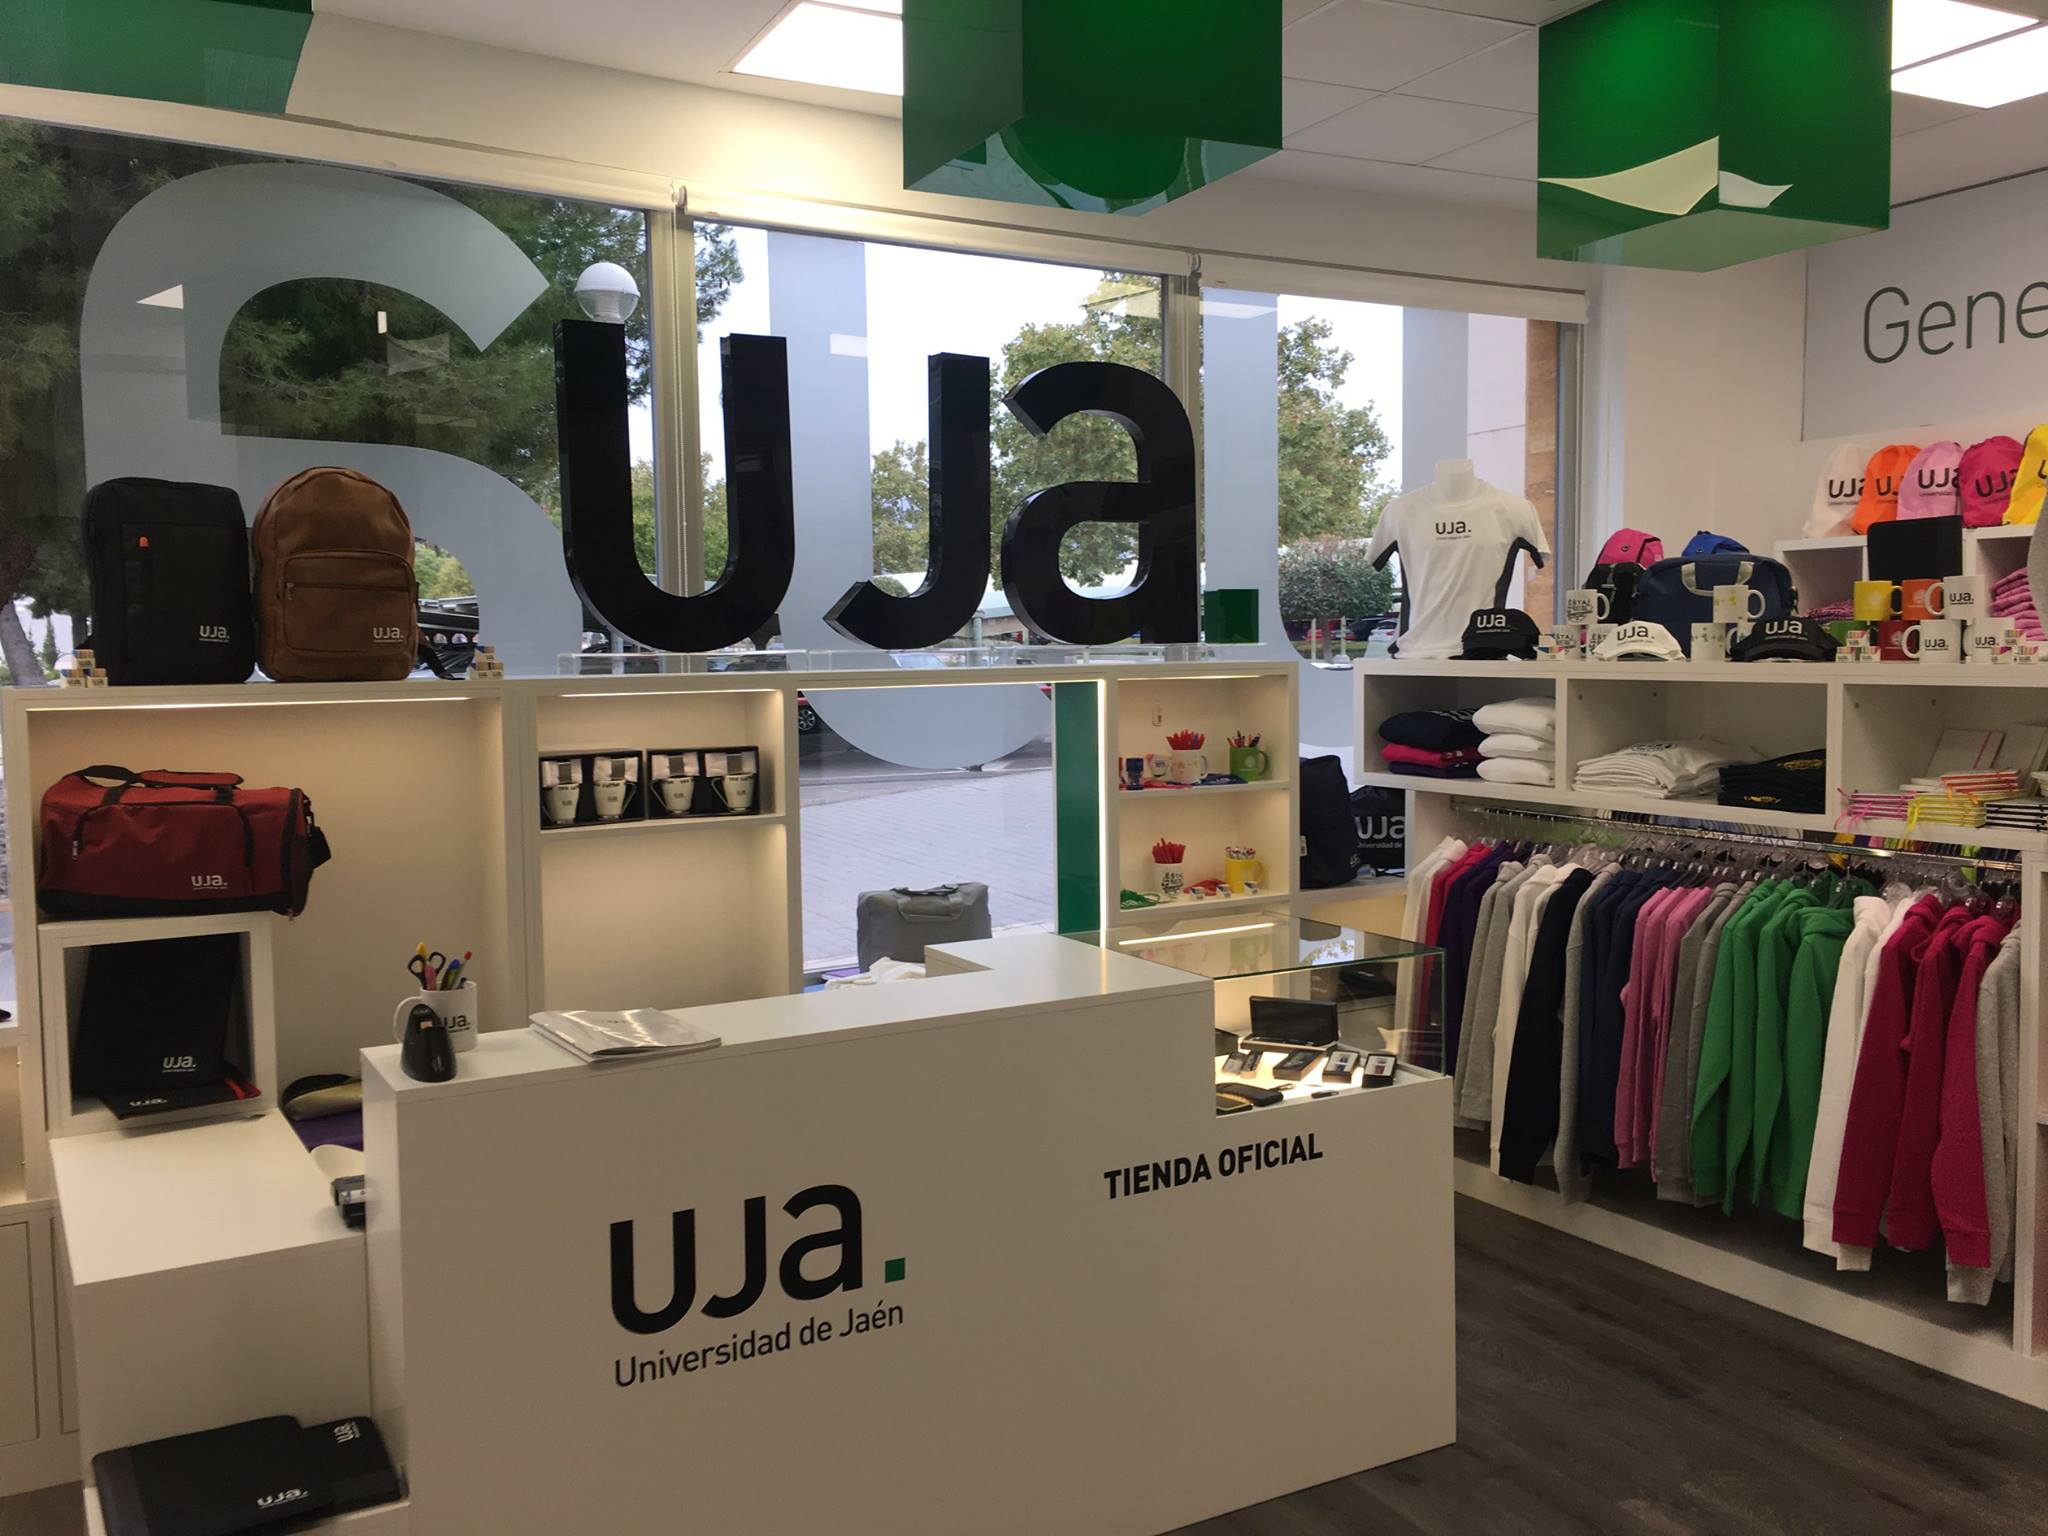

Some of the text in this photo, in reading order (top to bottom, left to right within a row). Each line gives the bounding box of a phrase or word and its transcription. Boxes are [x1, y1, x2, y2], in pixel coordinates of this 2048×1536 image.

[1103, 1133, 1324, 1200] TIENDA OFICIAL
[614, 1300, 904, 1387] Universidad de Jaén
